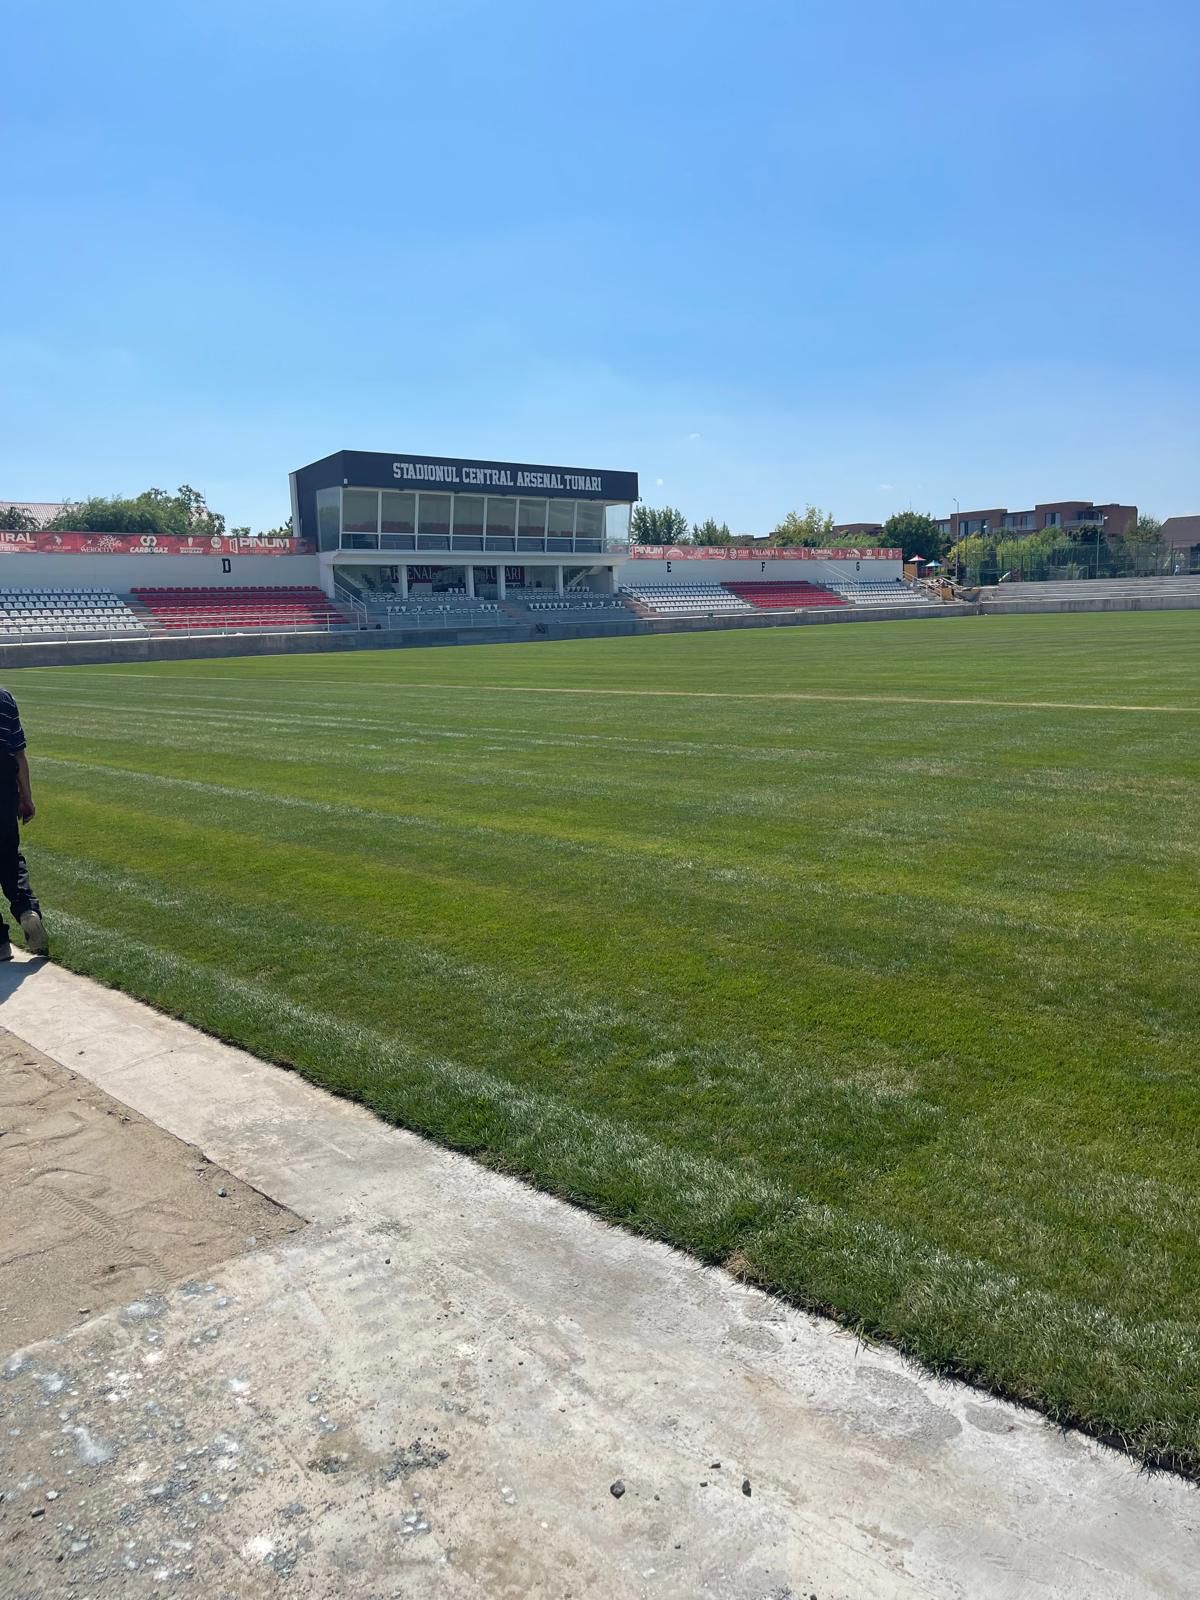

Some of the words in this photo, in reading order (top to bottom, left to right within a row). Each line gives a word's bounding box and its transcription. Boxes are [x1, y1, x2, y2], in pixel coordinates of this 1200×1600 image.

[393, 462, 460, 483] STADIONUL
[462, 467, 514, 486] CENTRAL
[516, 471, 563, 489] ARSENAL
[563, 474, 602, 491] TUNARI
[240, 537, 290, 548] PINUM
[129, 546, 169, 554] CARBOGAZ
[634, 546, 664, 555] PINUM
[222, 558, 231, 573] D
[666, 561, 672, 573] E
[761, 561, 766, 573] F
